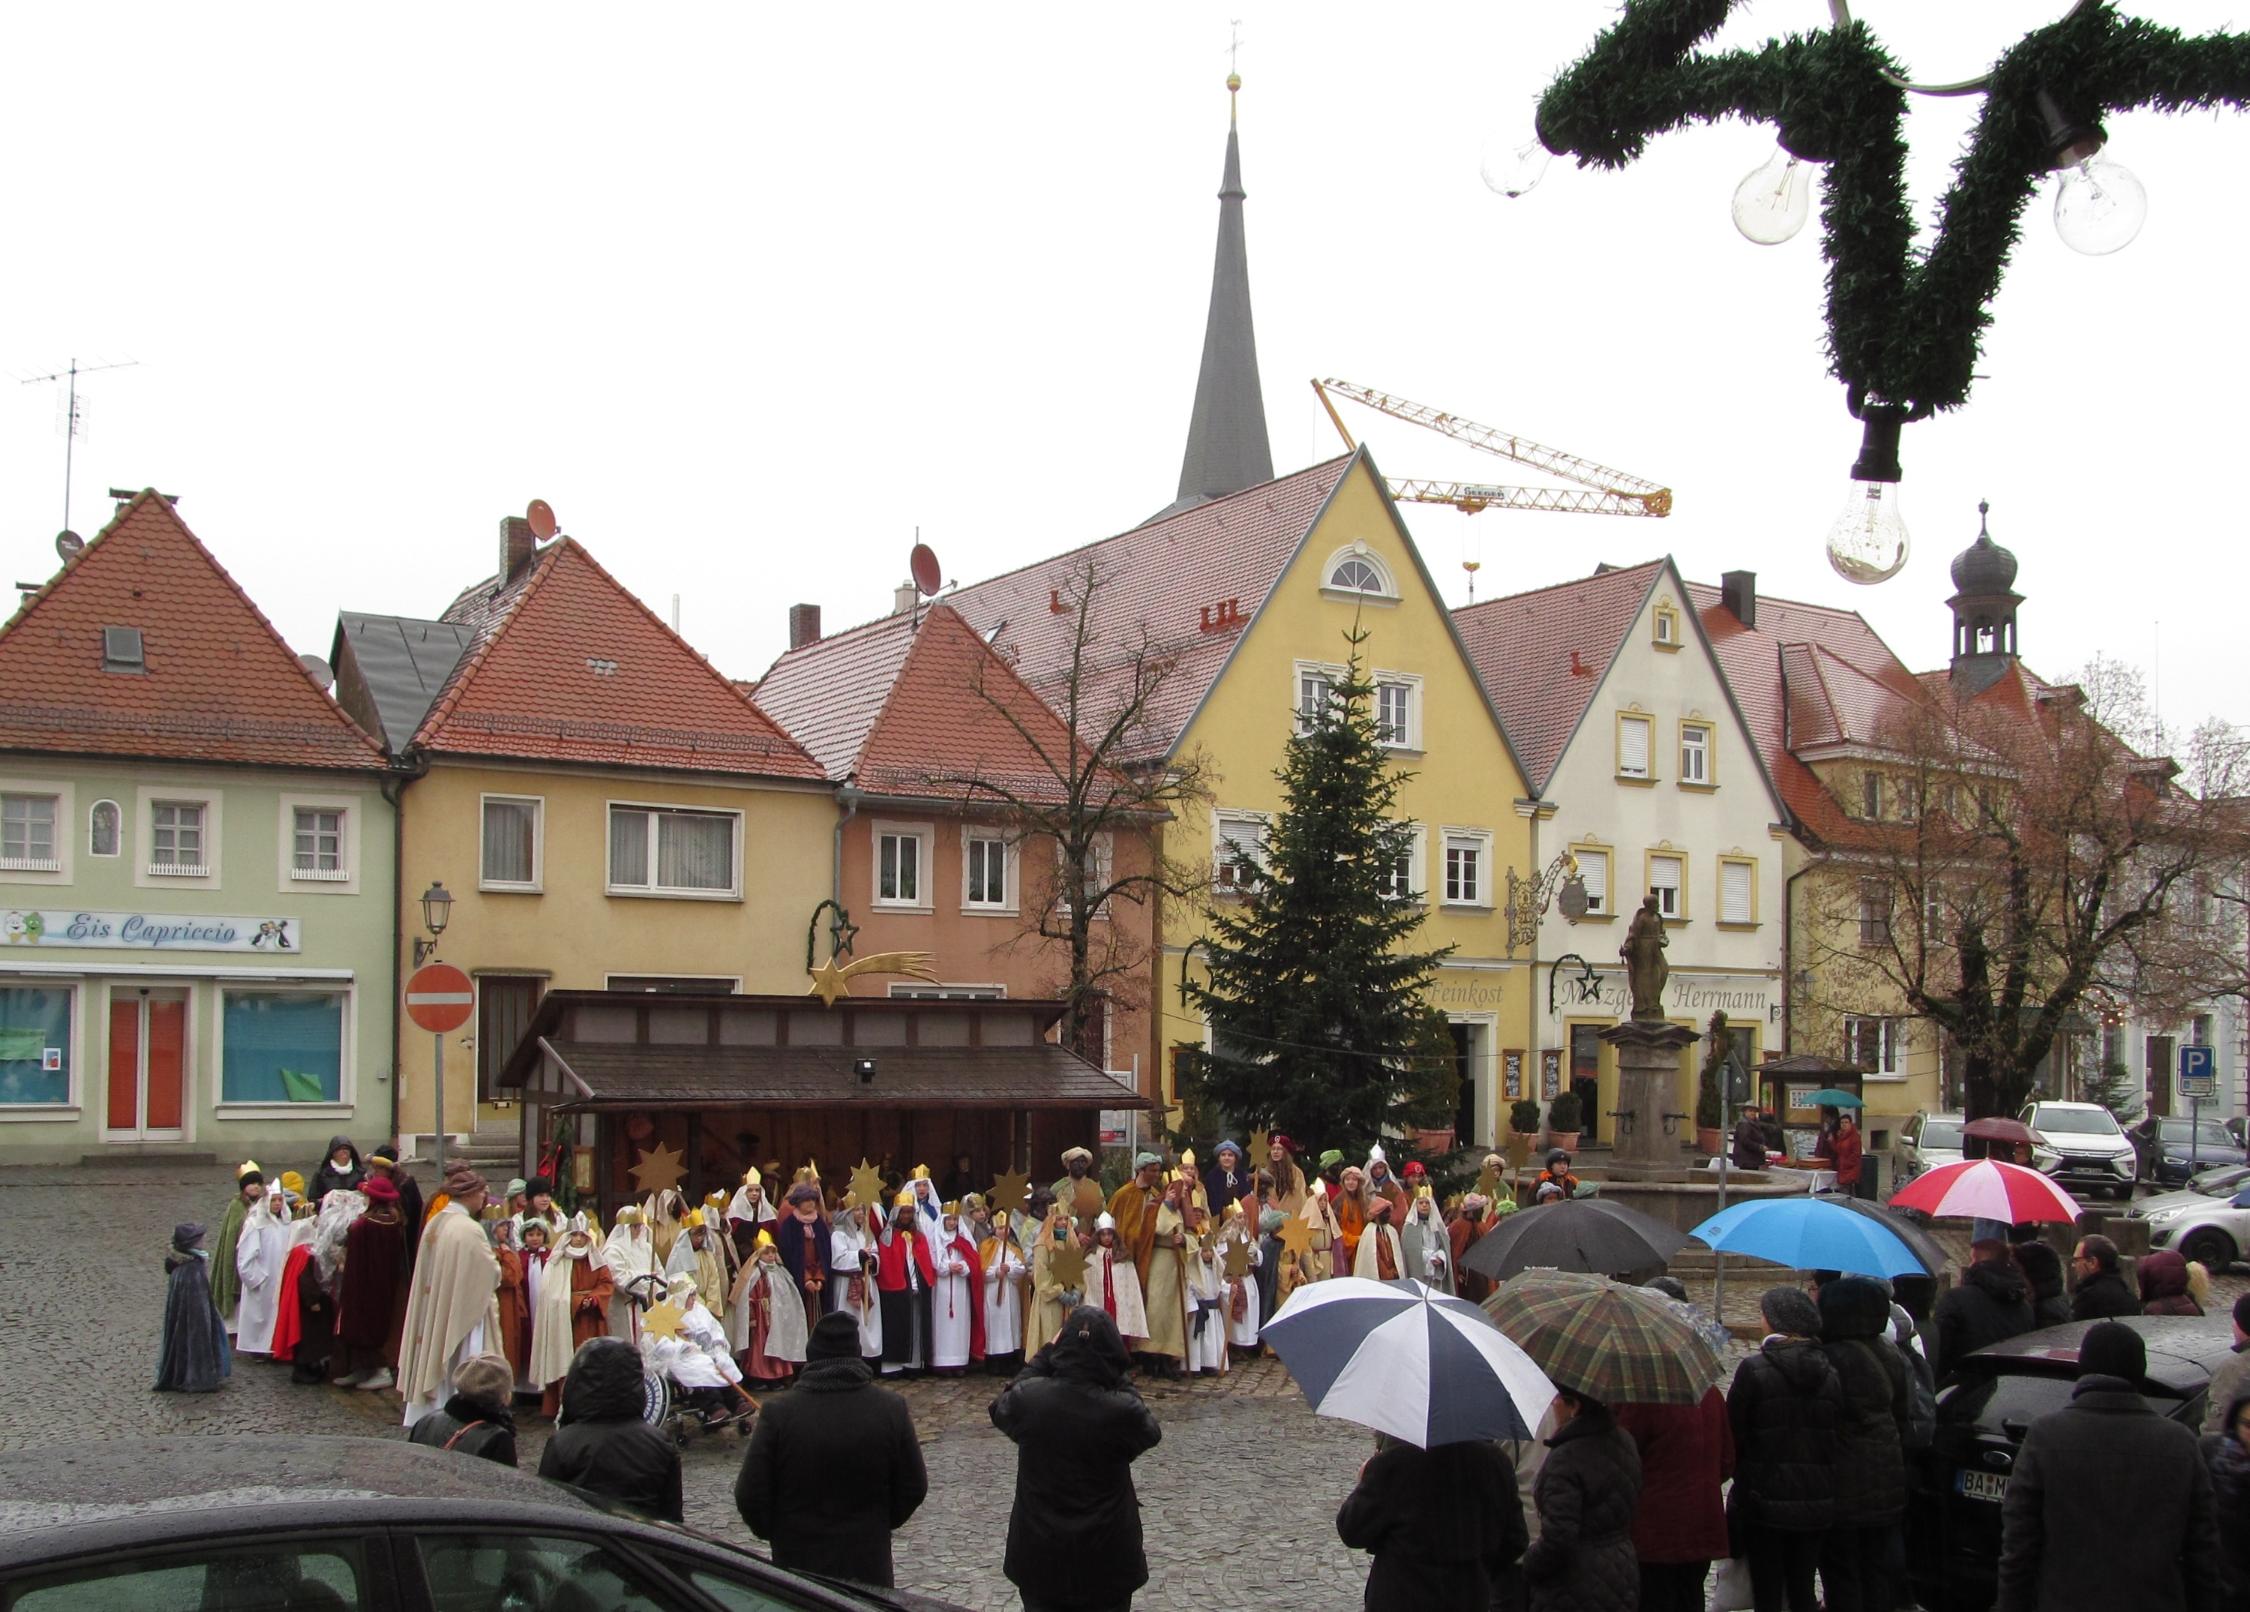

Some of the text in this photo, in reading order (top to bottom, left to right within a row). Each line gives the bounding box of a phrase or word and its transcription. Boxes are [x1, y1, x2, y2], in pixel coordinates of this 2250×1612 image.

[66, 913, 236, 946] Eis Capriccio
[1429, 978, 1505, 1008] Feinkost
[1672, 982, 1766, 1009] Herrmann
[2187, 1051, 2205, 1074] P
[1964, 1472, 1984, 1493] BA
